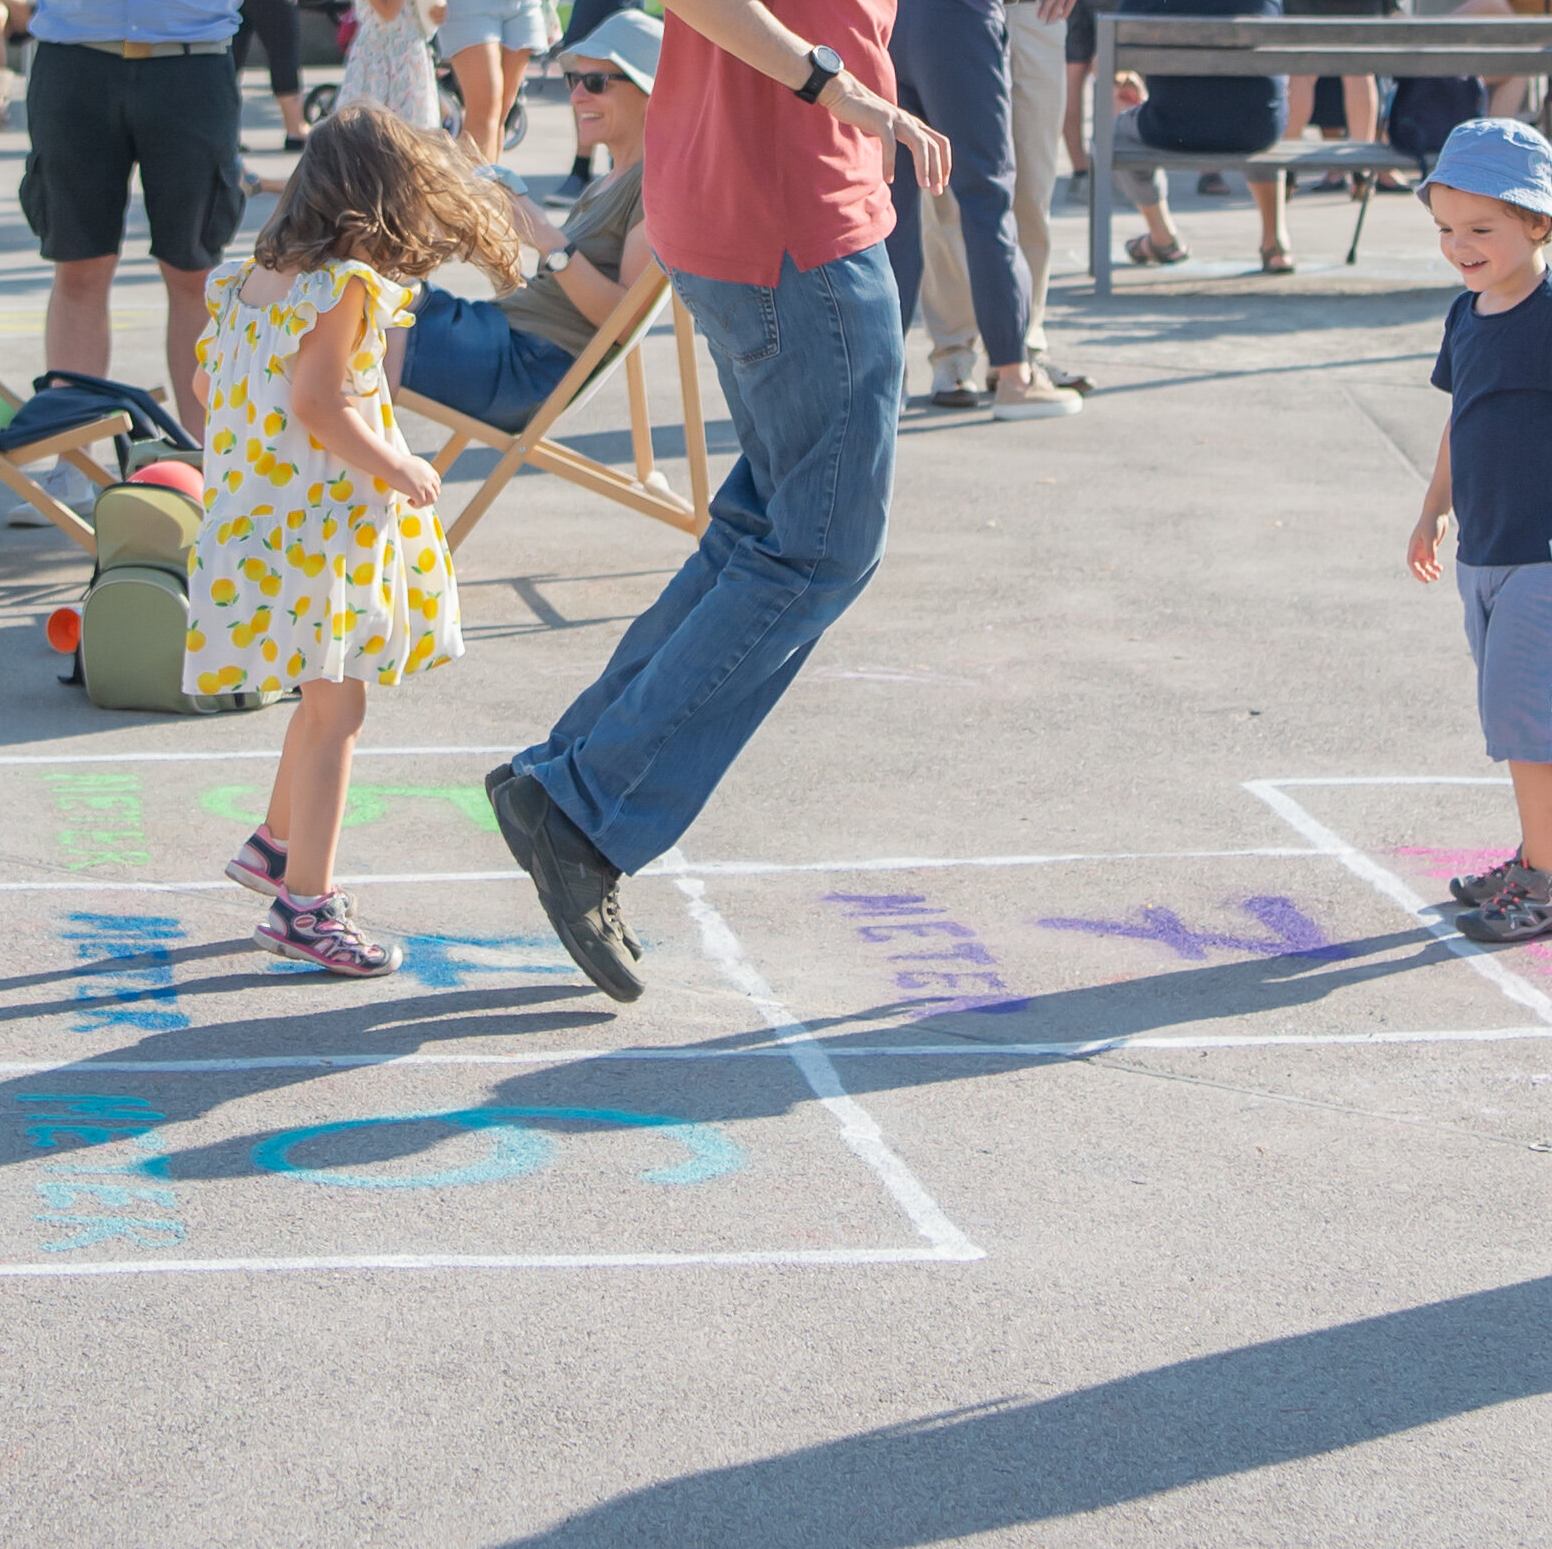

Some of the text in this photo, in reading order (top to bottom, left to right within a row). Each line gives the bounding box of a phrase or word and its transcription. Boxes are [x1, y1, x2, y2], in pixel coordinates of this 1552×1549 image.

[43, 772, 151, 871] METER
[61, 912, 192, 1034] METER
[820, 894, 1034, 1018] METER
[1035, 895, 1348, 963] 7
[14, 1093, 186, 1251] METER
[253, 1105, 743, 1190] 6
